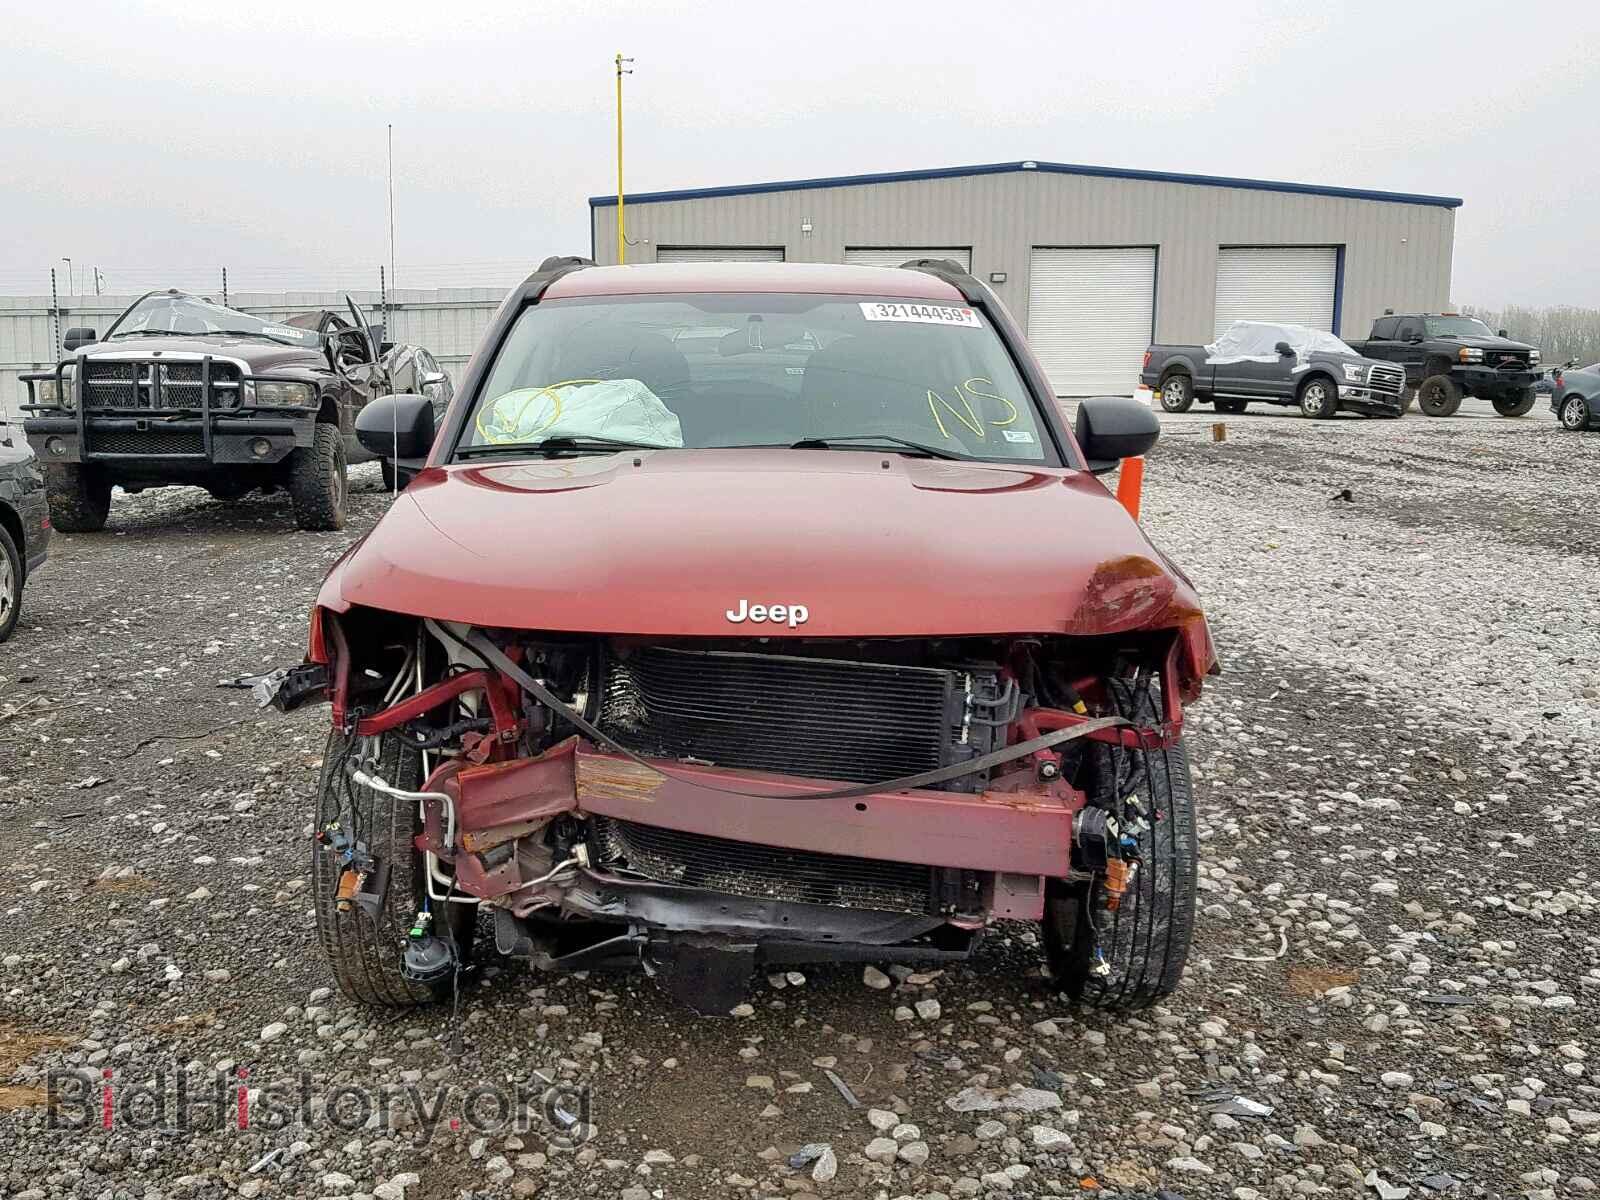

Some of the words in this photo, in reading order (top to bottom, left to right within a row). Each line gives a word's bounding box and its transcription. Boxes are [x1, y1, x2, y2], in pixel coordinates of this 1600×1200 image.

[876, 303, 964, 322] 32144459
[927, 377, 1018, 439] NS
[726, 599, 809, 629] Jeep
